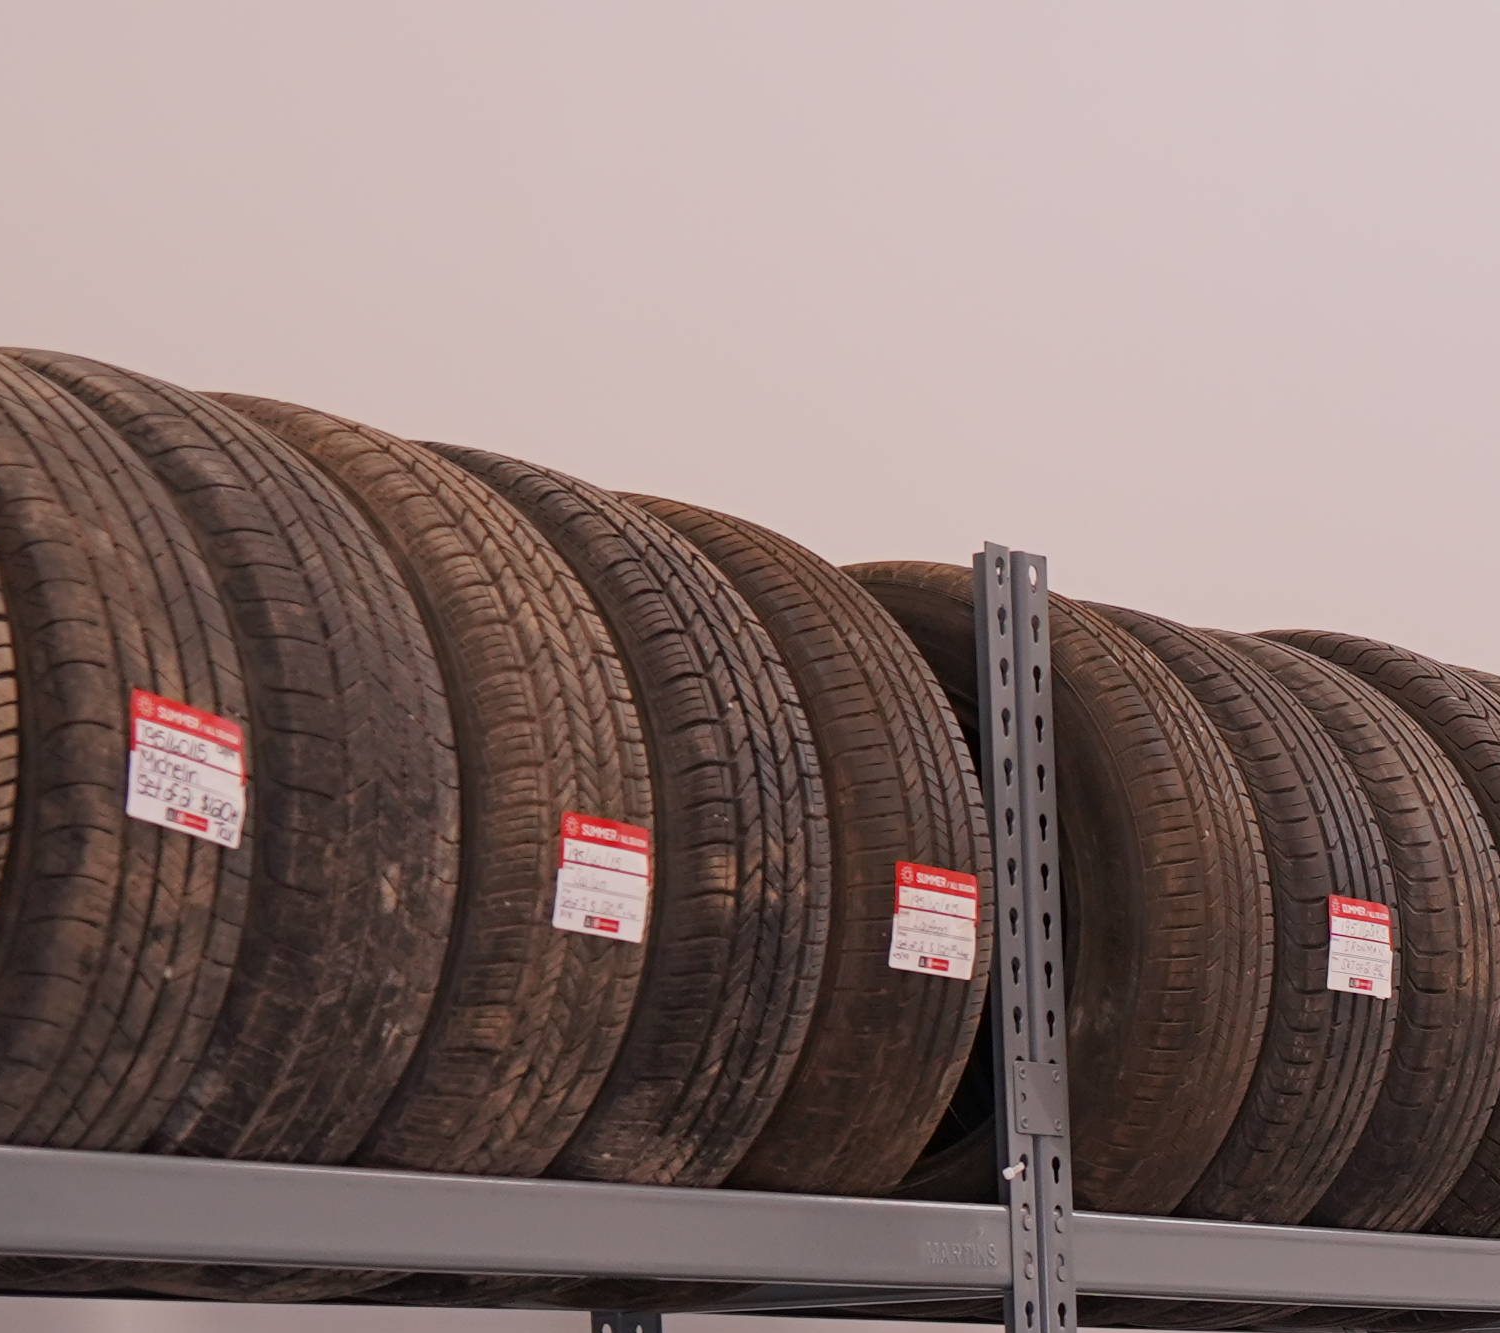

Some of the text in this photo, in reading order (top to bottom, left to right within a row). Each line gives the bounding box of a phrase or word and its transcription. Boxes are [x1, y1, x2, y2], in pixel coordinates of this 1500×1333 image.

[157, 706, 199, 729] SUMMER
[581, 823, 617, 841] SUMMER
[916, 872, 947, 887] SUMMER
[1342, 904, 1366, 916] SUMMER
[1345, 941, 1383, 955] IRONMAN
